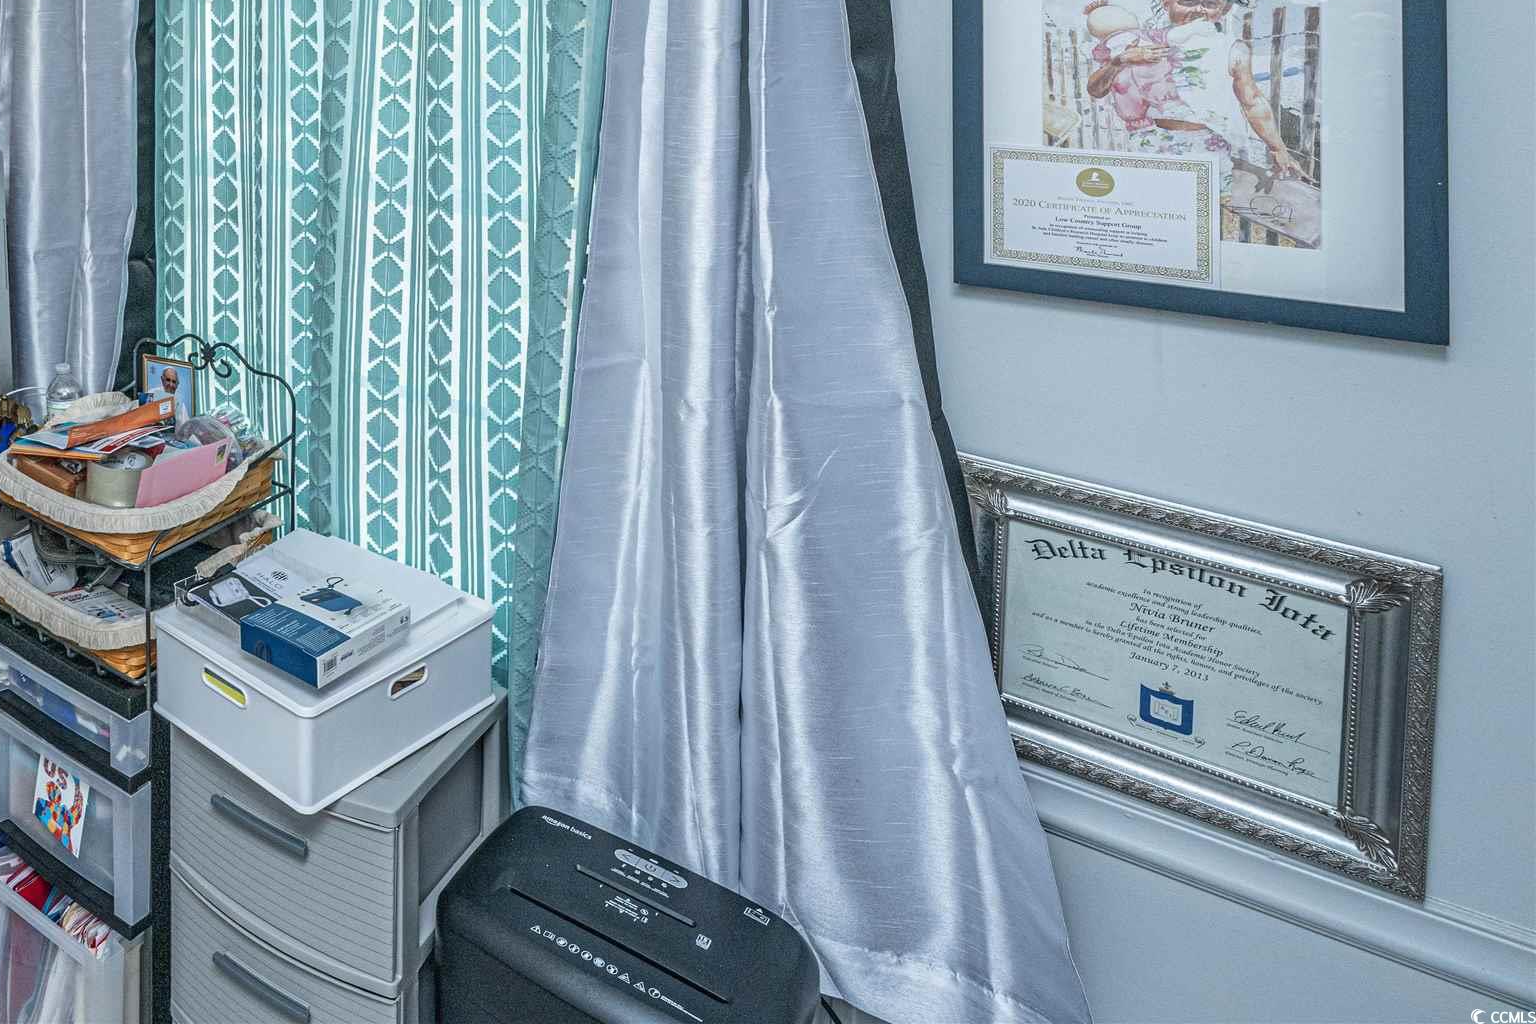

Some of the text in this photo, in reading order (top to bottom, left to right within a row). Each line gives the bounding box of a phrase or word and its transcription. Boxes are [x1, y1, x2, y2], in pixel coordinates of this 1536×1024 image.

[1012, 198, 1036, 207] 2020
[1070, 217, 1094, 226] Country
[1096, 220, 1121, 228] Support
[1121, 222, 1142, 231] Group
[1024, 538, 1337, 641] Delta Epsilon Iota
[1119, 620, 1224, 658] Lifetime Membership
[1129, 650, 1170, 671] January
[541, 814, 593, 840] amazon basics
